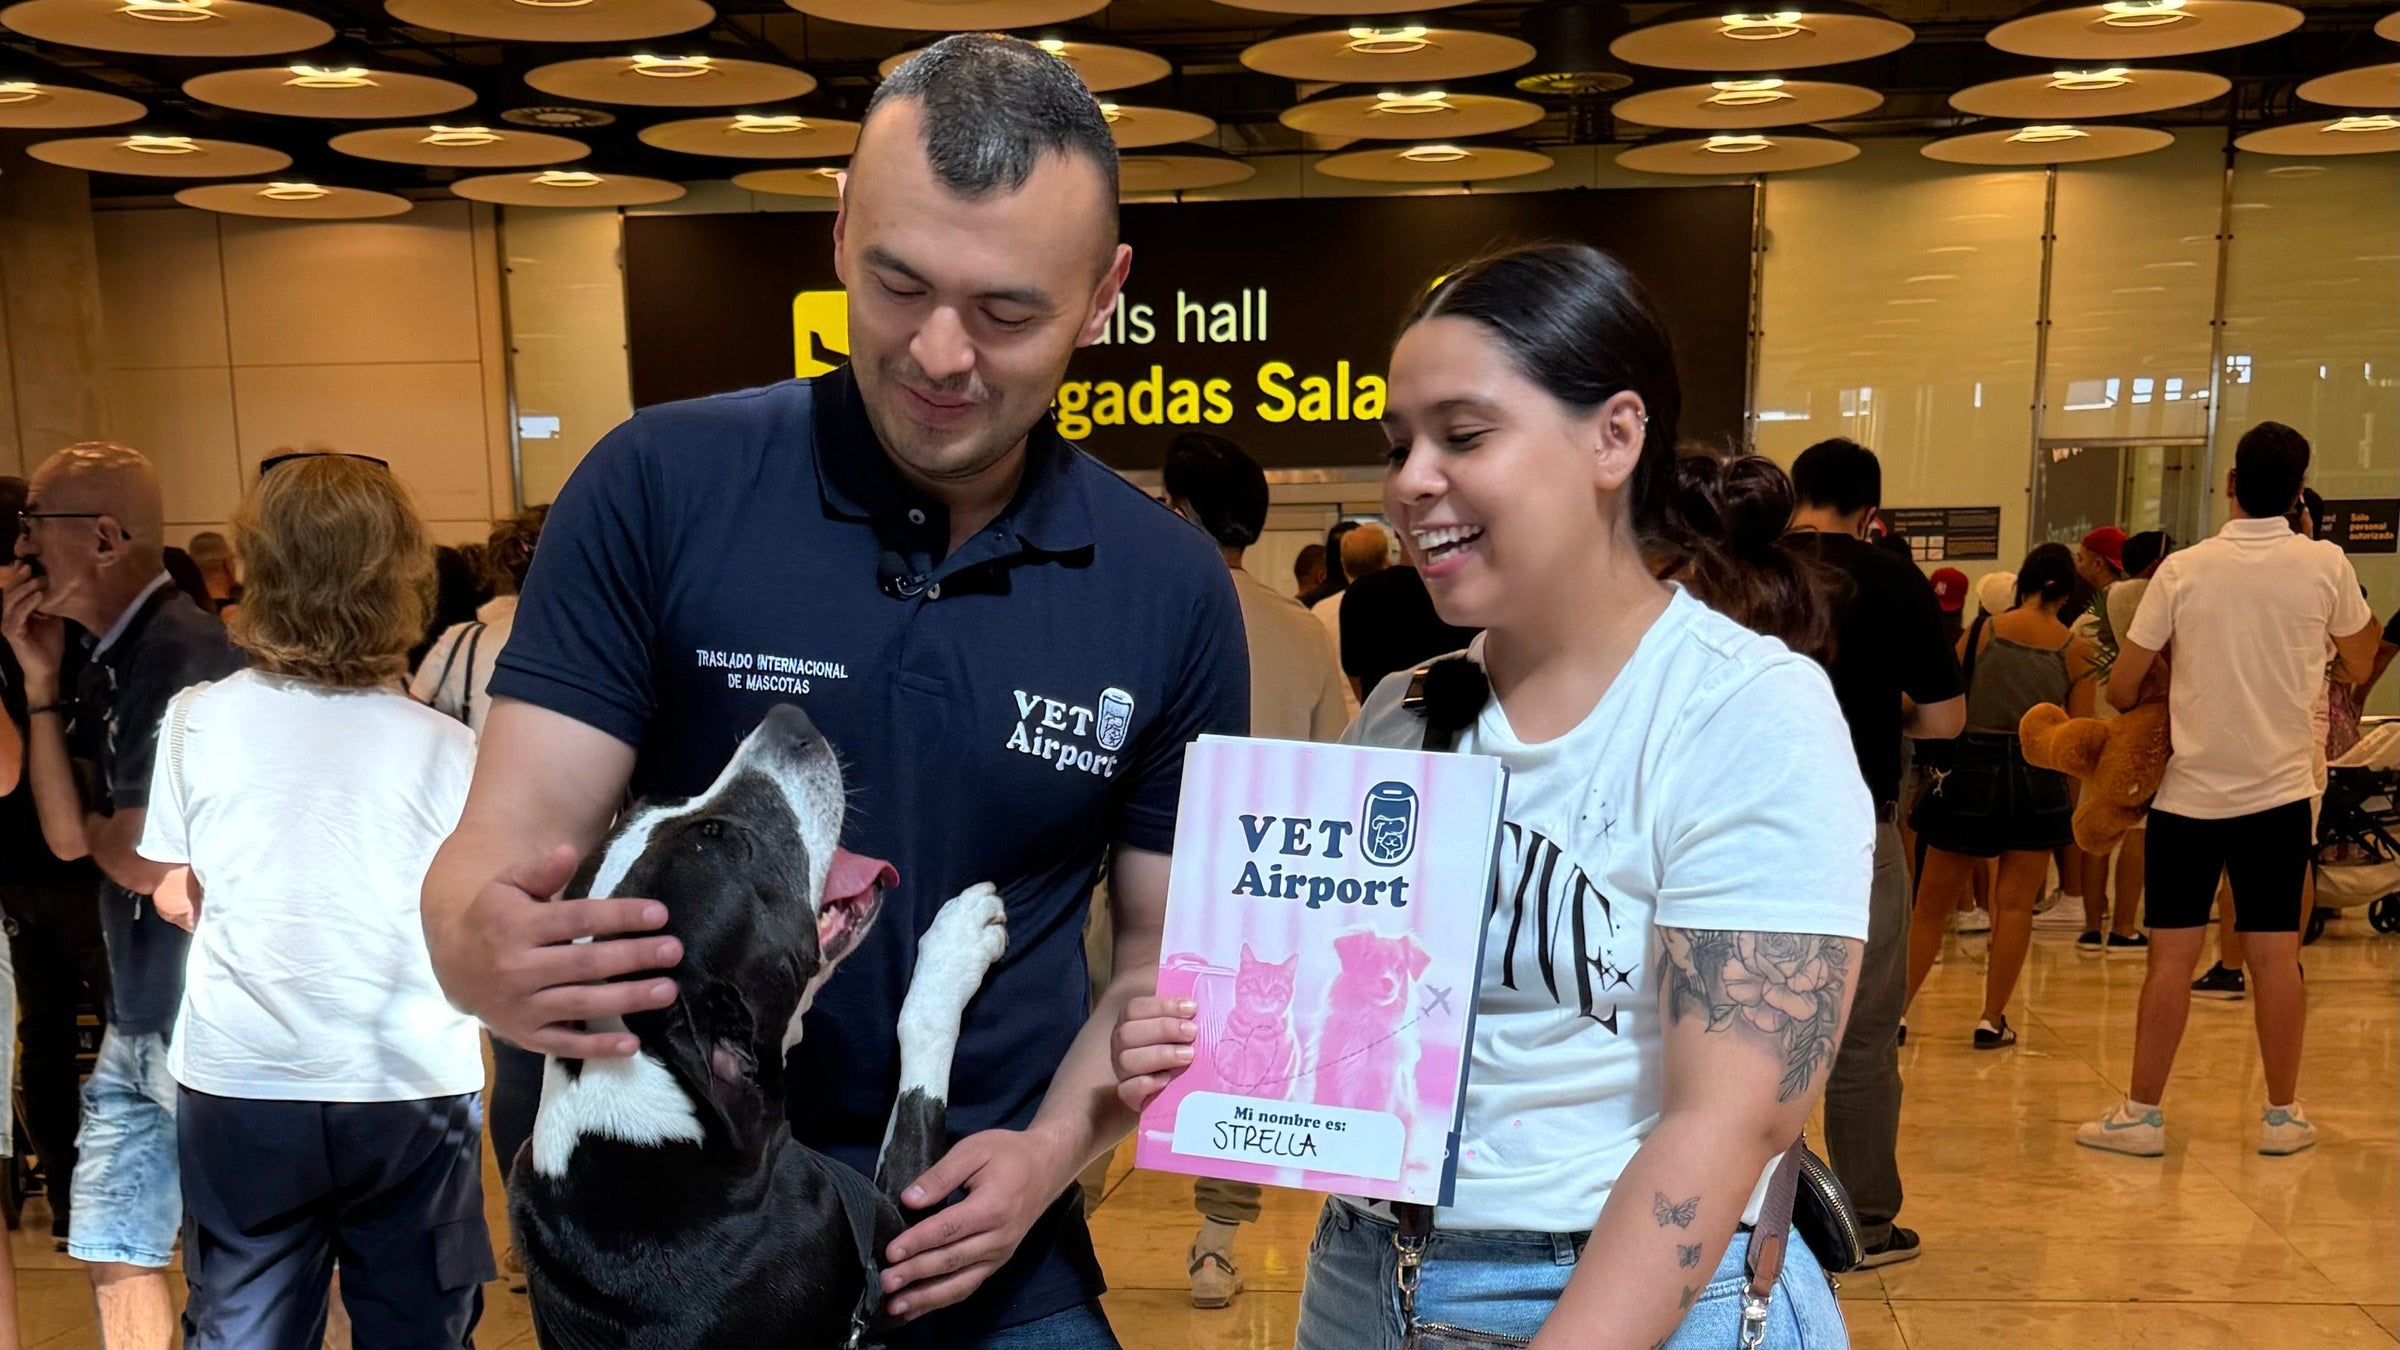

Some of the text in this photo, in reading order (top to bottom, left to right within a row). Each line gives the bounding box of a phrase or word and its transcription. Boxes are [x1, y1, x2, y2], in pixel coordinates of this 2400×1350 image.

[1177, 287, 1268, 343] hall
[1050, 361, 1387, 440] gadas Sala
[696, 649, 849, 679] TRASLADO INTERNACIONAL
[728, 673, 810, 695] DE MASCOTAS
[1013, 689, 1094, 736] VET
[1006, 720, 1118, 778] Airport
[1239, 814, 1353, 859] VET
[1231, 860, 1410, 910] Airport
[1212, 1120, 1318, 1157] STRELLA
[1234, 1106, 1347, 1132] Mi nombre es:
